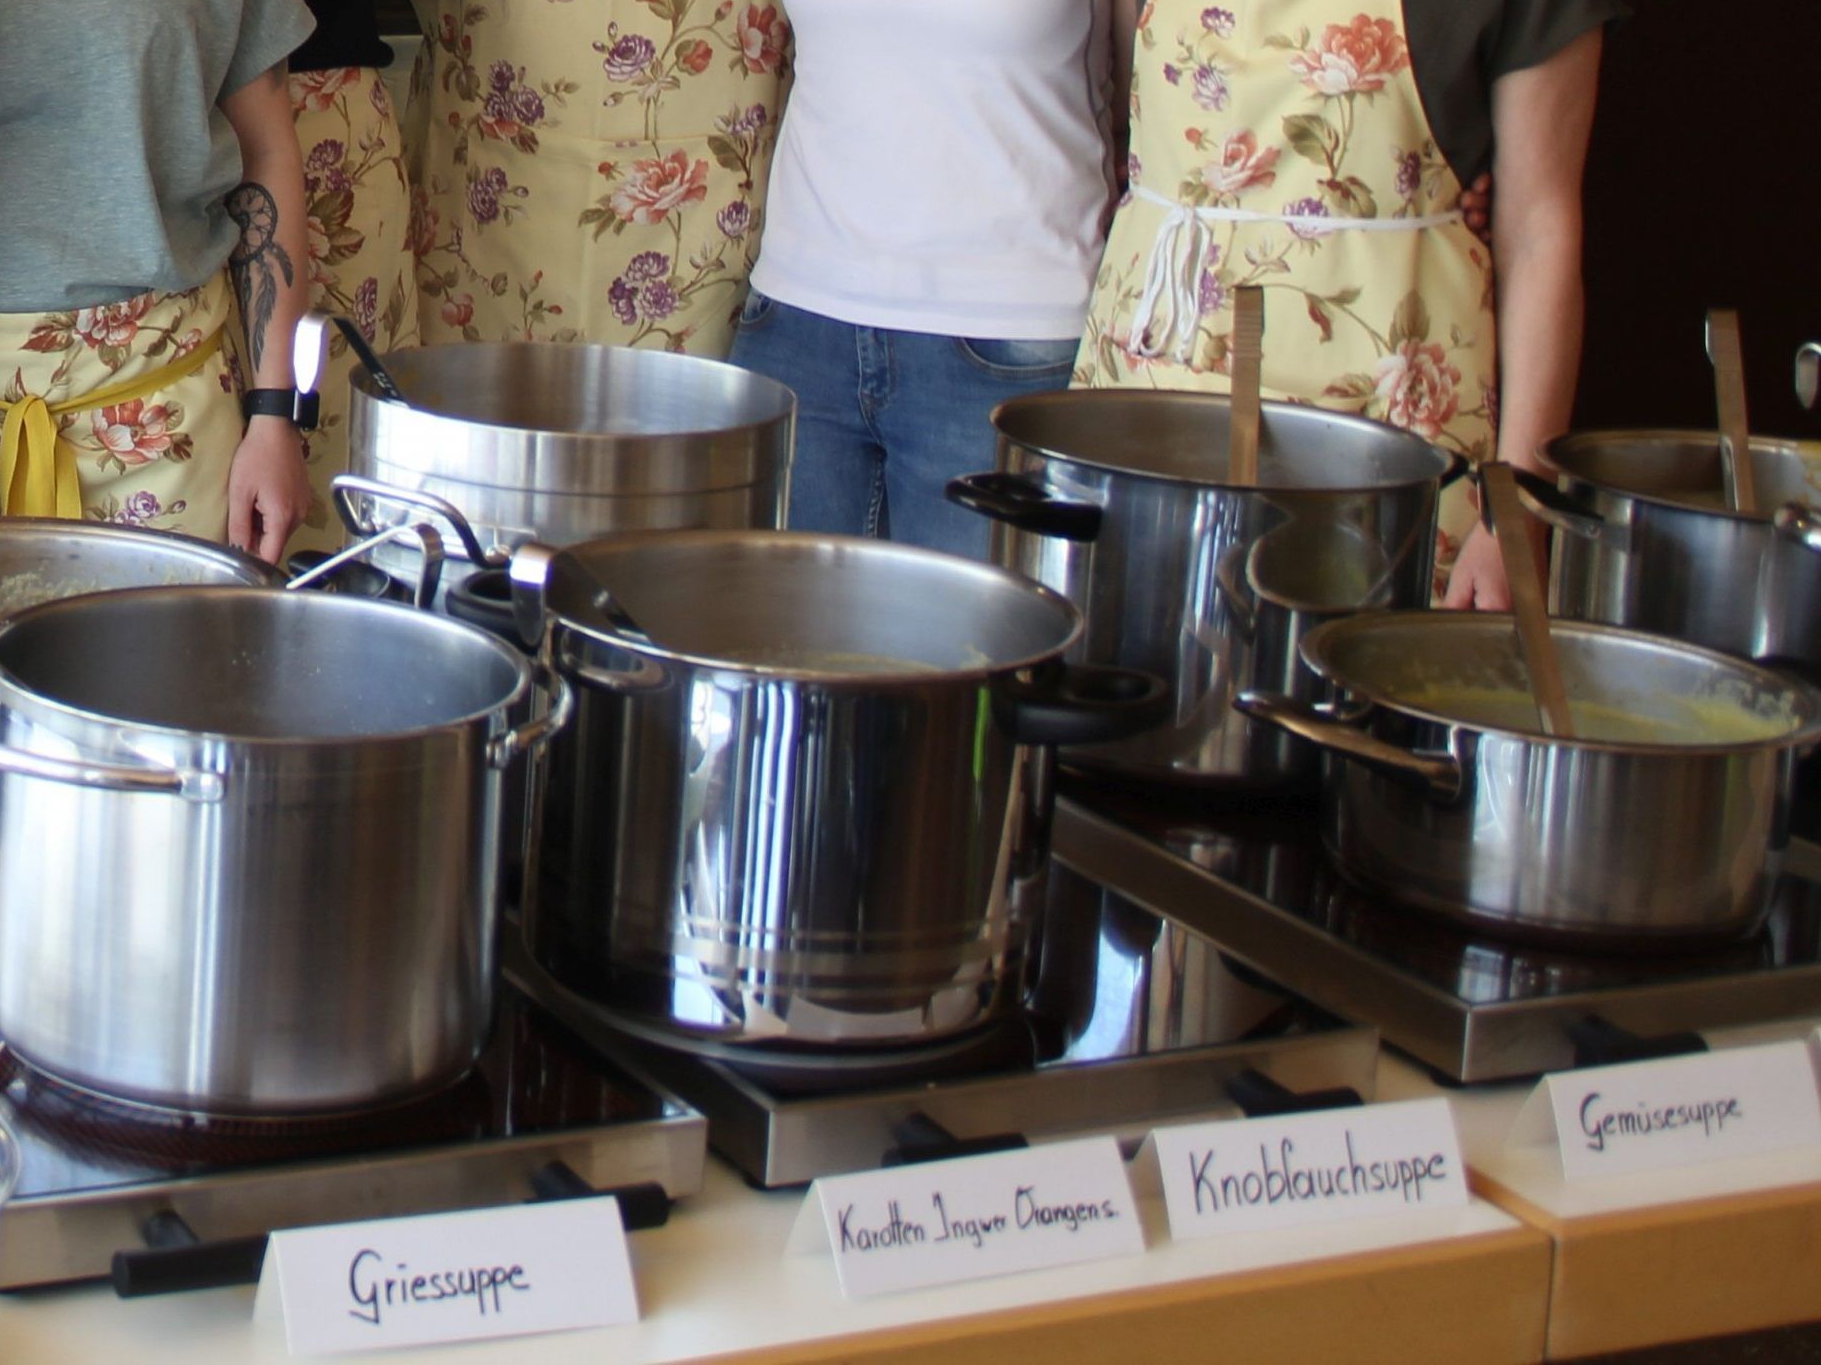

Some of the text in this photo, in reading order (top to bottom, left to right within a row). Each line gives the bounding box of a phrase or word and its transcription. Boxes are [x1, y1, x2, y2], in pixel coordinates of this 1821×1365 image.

[1580, 1092, 1742, 1152] Gemüsesuppe
[1188, 1130, 1447, 1215] Knoblauchsuppe
[838, 1201, 925, 1253] Karotten
[931, 1190, 1007, 1248] Ingwer
[349, 1248, 530, 1325] Griessuppe
